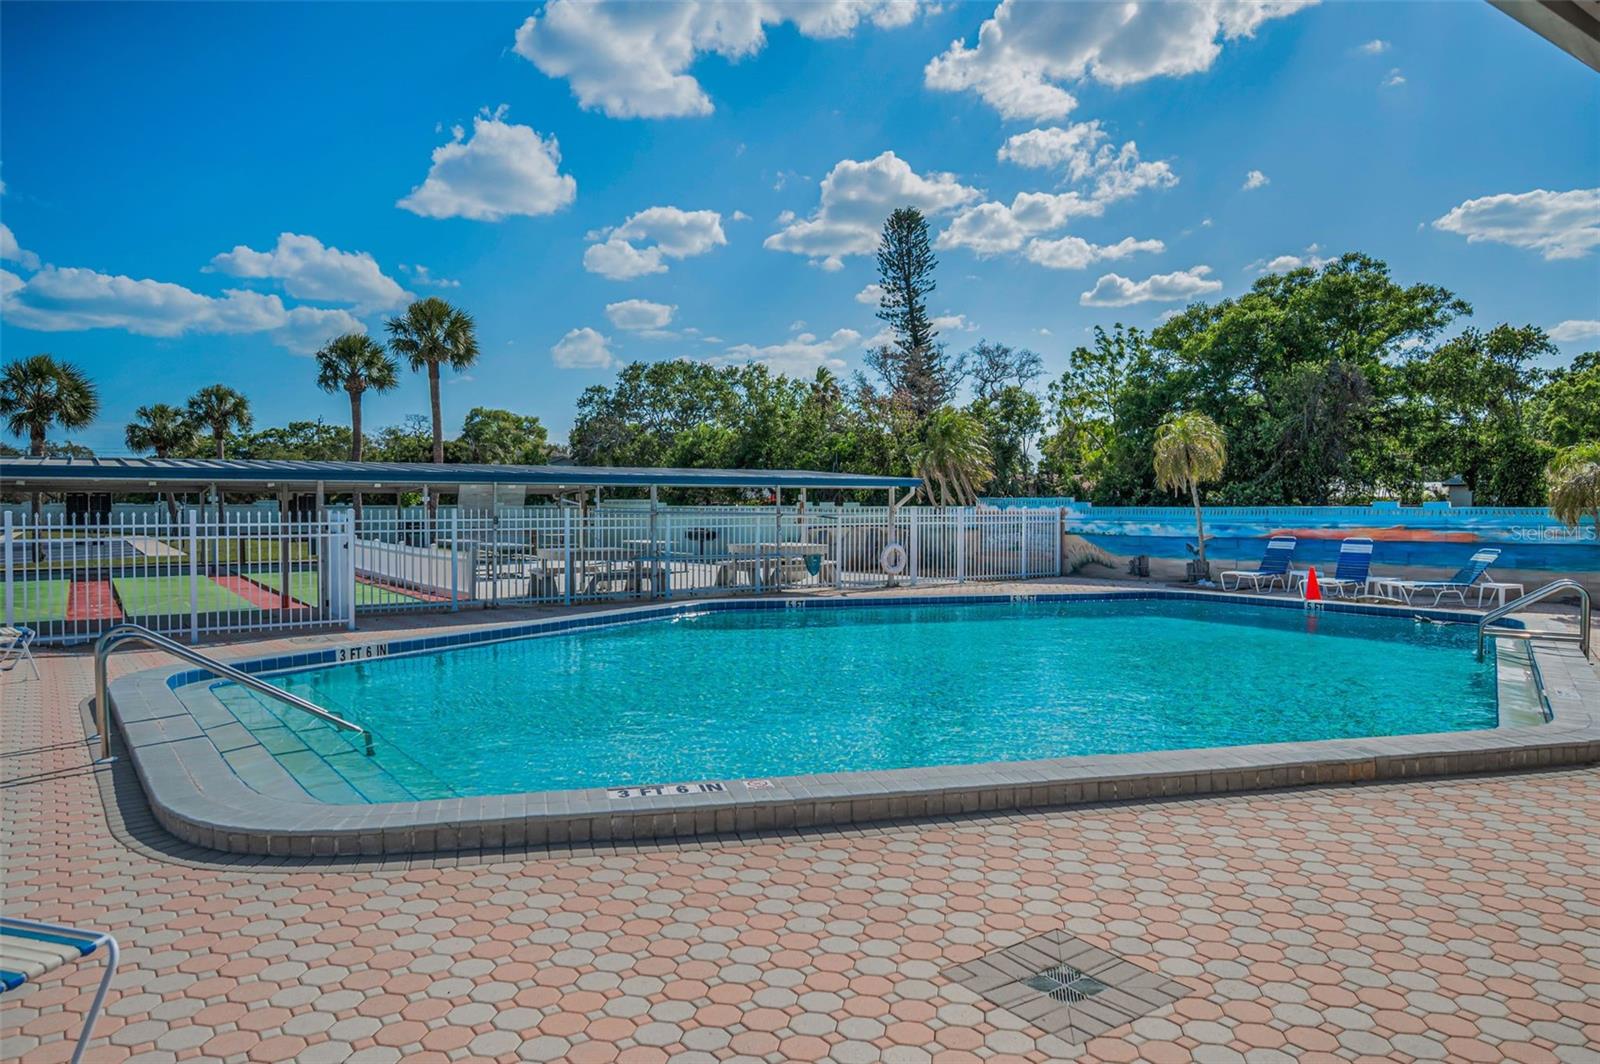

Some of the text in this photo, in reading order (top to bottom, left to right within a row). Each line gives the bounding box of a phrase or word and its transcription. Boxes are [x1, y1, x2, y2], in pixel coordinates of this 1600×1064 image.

[1306, 601, 1323, 611] 5 FT
[339, 643, 387, 662] 3 FT 6 IN
[617, 782, 724, 798] 3 FT 6 IN
